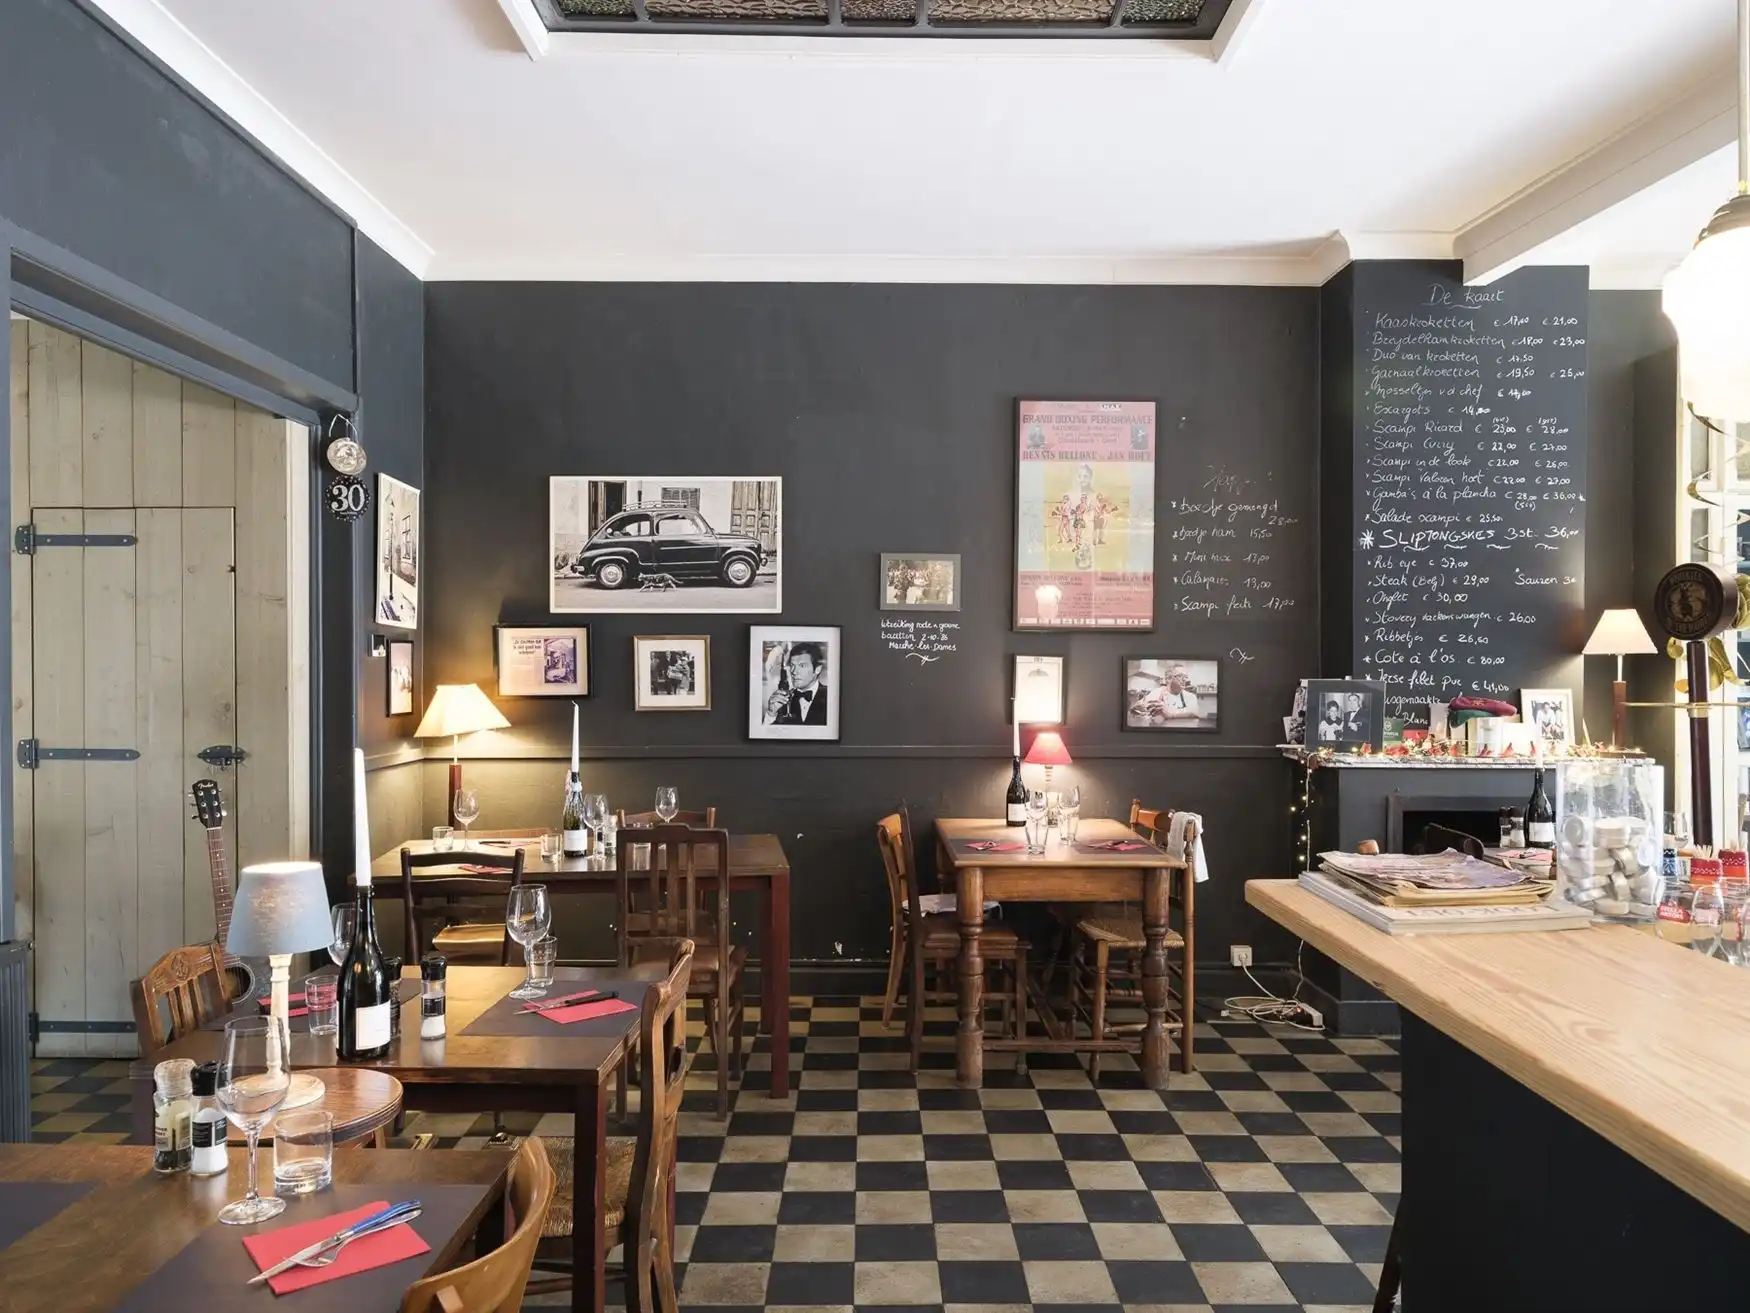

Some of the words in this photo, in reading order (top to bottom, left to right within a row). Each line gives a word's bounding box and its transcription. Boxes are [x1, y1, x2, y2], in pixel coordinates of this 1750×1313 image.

[1421, 283, 1451, 305] De
[1376, 313, 1475, 331] Kaaskroketten
[1372, 348, 1396, 361] Duo
[1402, 351, 1420, 361] van
[1426, 349, 1479, 365] kroketten
[1506, 366, 1535, 379] 19,50
[1460, 383, 1484, 404] chef
[1022, 414, 1053, 424] GRAND
[1090, 414, 1153, 425] PERFORMANCE
[1373, 419, 1416, 437] Scampi
[1425, 419, 1463, 433] Ricard
[1492, 423, 1516, 435] 23,00
[1374, 436, 1413, 453] Scampi
[1423, 437, 1455, 456] Curry
[1372, 453, 1411, 471] Scampi
[1416, 458, 1426, 467] in
[1428, 456, 1440, 466] de
[1445, 453, 1472, 466] look
[1372, 469, 1410, 487] Scampi
[331, 484, 365, 512] 30
[1436, 485, 1448, 500] la
[1453, 486, 1497, 505] plancha
[1371, 508, 1413, 524] Salade
[1418, 513, 1461, 527] scampi
[1379, 529, 1496, 548] SLIPTONGSKES
[1544, 526, 1579, 539] 36,00
[1374, 556, 1393, 569] Rib
[1400, 560, 1417, 572] eye
[1441, 557, 1469, 569] 37,00
[1373, 574, 1408, 587] Steak
[1515, 573, 1558, 585] Sauzen
[1373, 590, 1408, 611] Onglet
[1436, 592, 1468, 604] 30,00
[1408, 669, 1436, 689] filet
